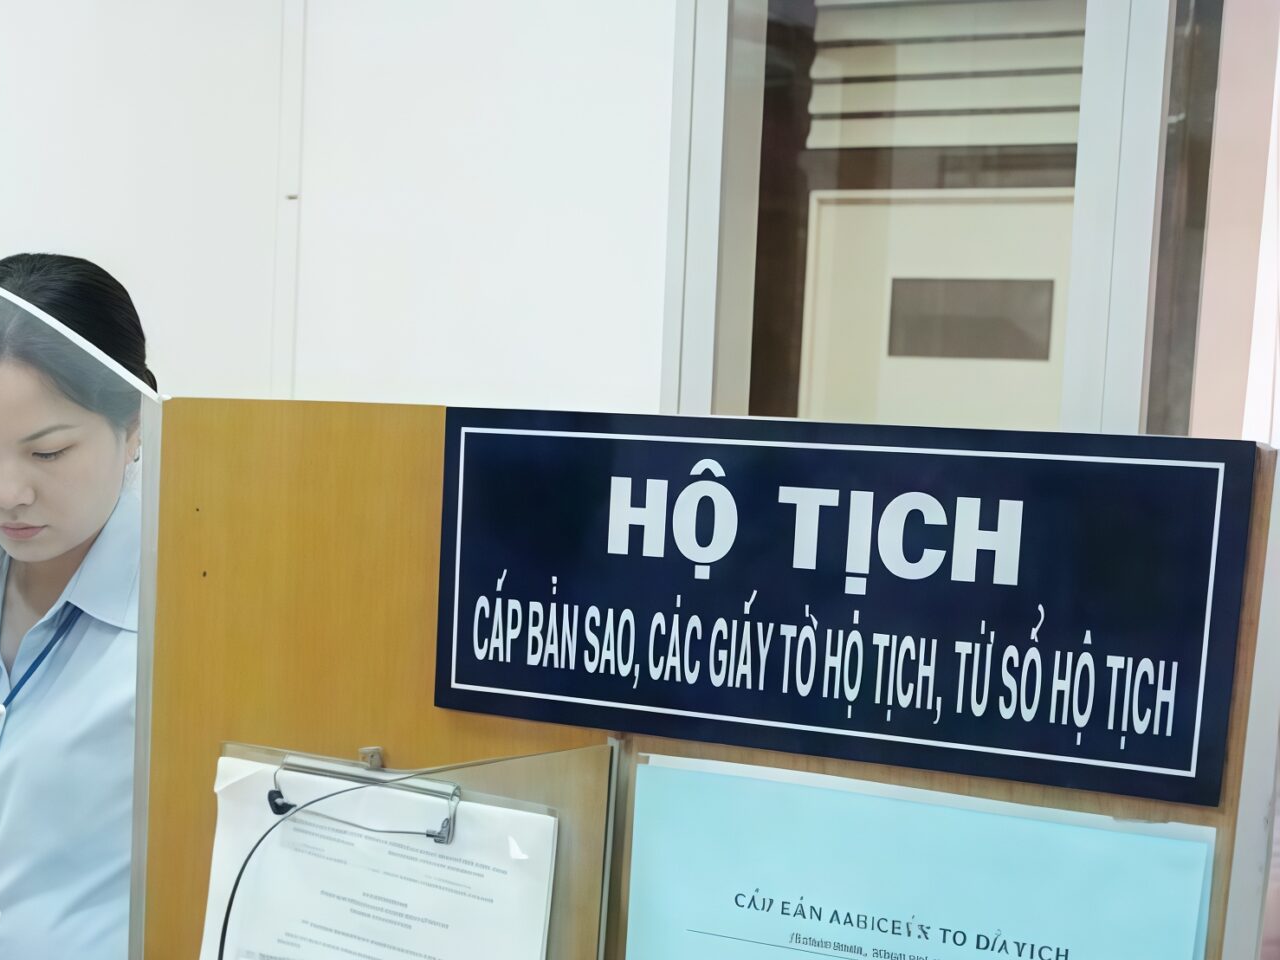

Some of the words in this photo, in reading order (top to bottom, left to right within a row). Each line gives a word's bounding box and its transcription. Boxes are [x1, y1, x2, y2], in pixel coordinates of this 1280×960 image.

[607, 458, 739, 580] HỘ
[778, 485, 1024, 596] TỊCH
[583, 605, 640, 690] SAO,
[648, 594, 703, 685] CÁC
[872, 632, 942, 726] TỊCH,
[1049, 629, 1096, 747] HỘ
[1106, 655, 1179, 751] TỊCH
